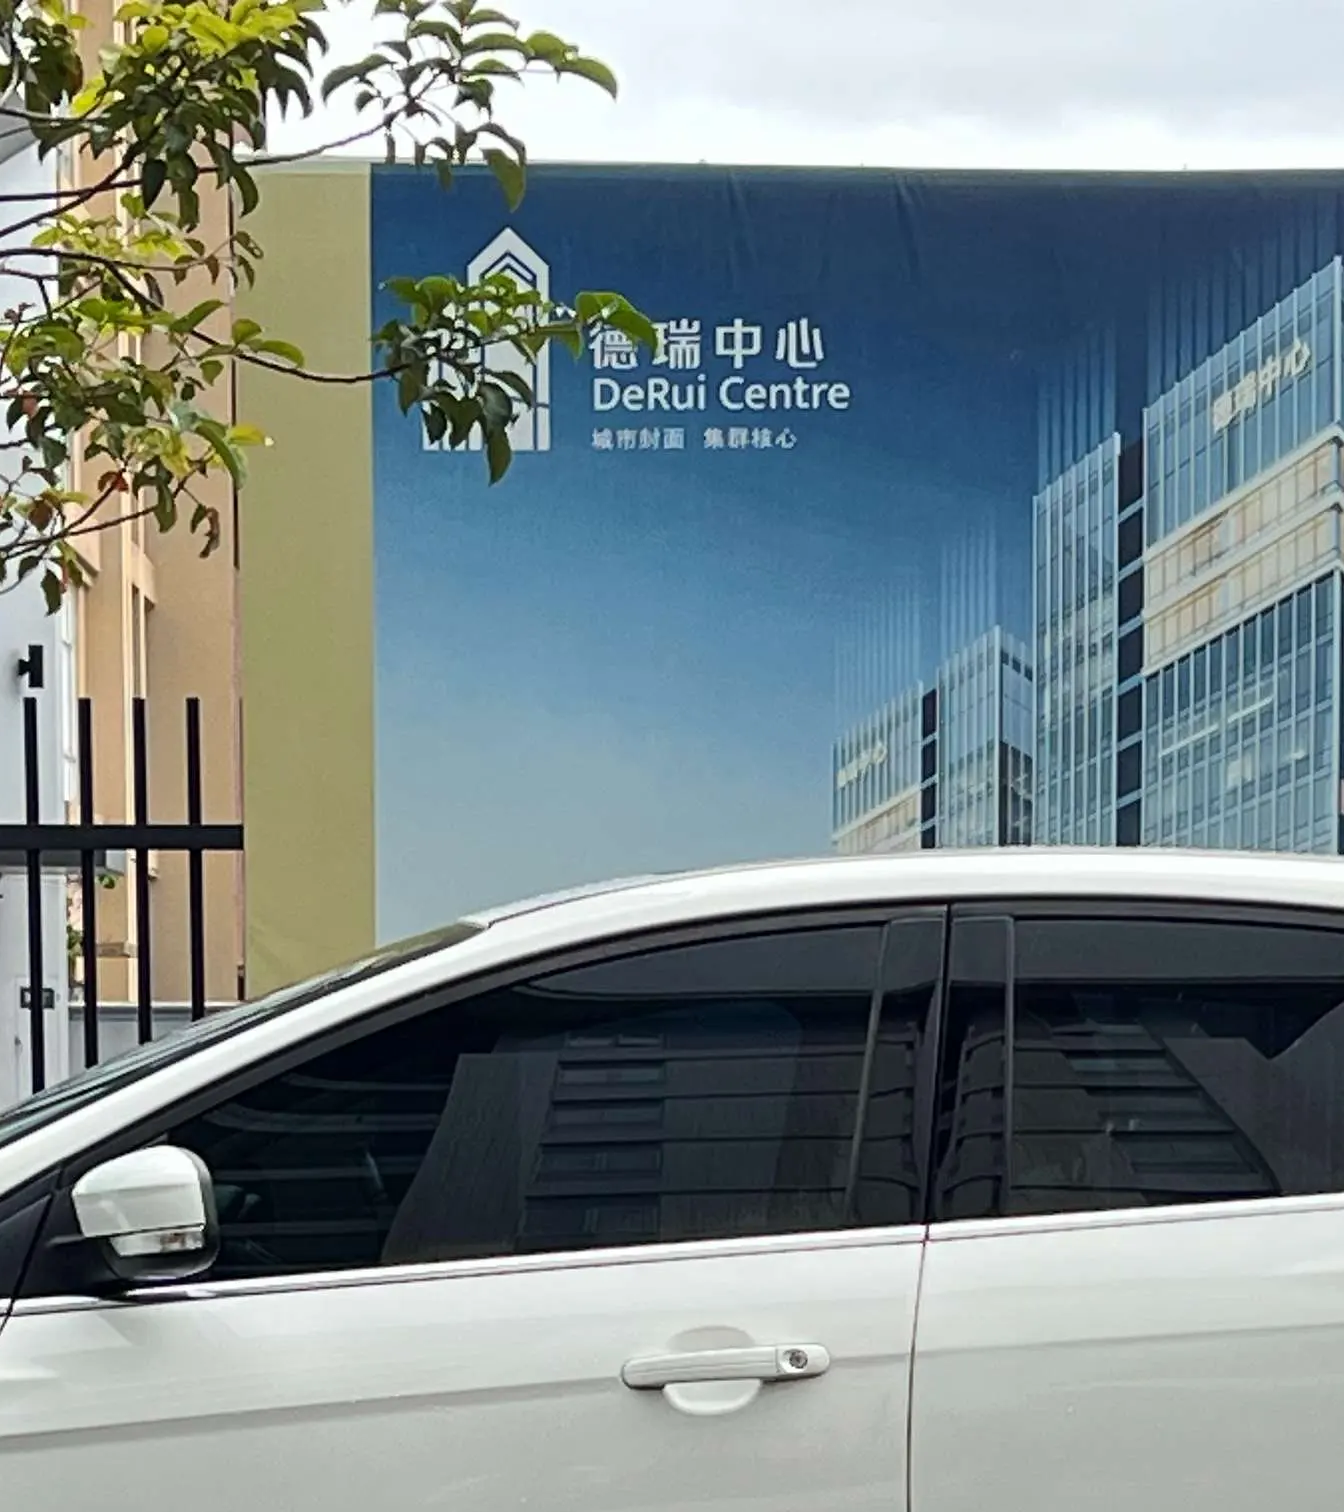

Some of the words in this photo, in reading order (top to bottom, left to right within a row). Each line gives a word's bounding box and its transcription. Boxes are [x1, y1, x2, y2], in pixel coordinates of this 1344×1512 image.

[588, 316, 826, 371] 德瑞中心
[593, 373, 707, 411] DeRui
[718, 375, 851, 411] Centre
[591, 427, 685, 450] 城市封面
[703, 427, 797, 449] 集群核心
